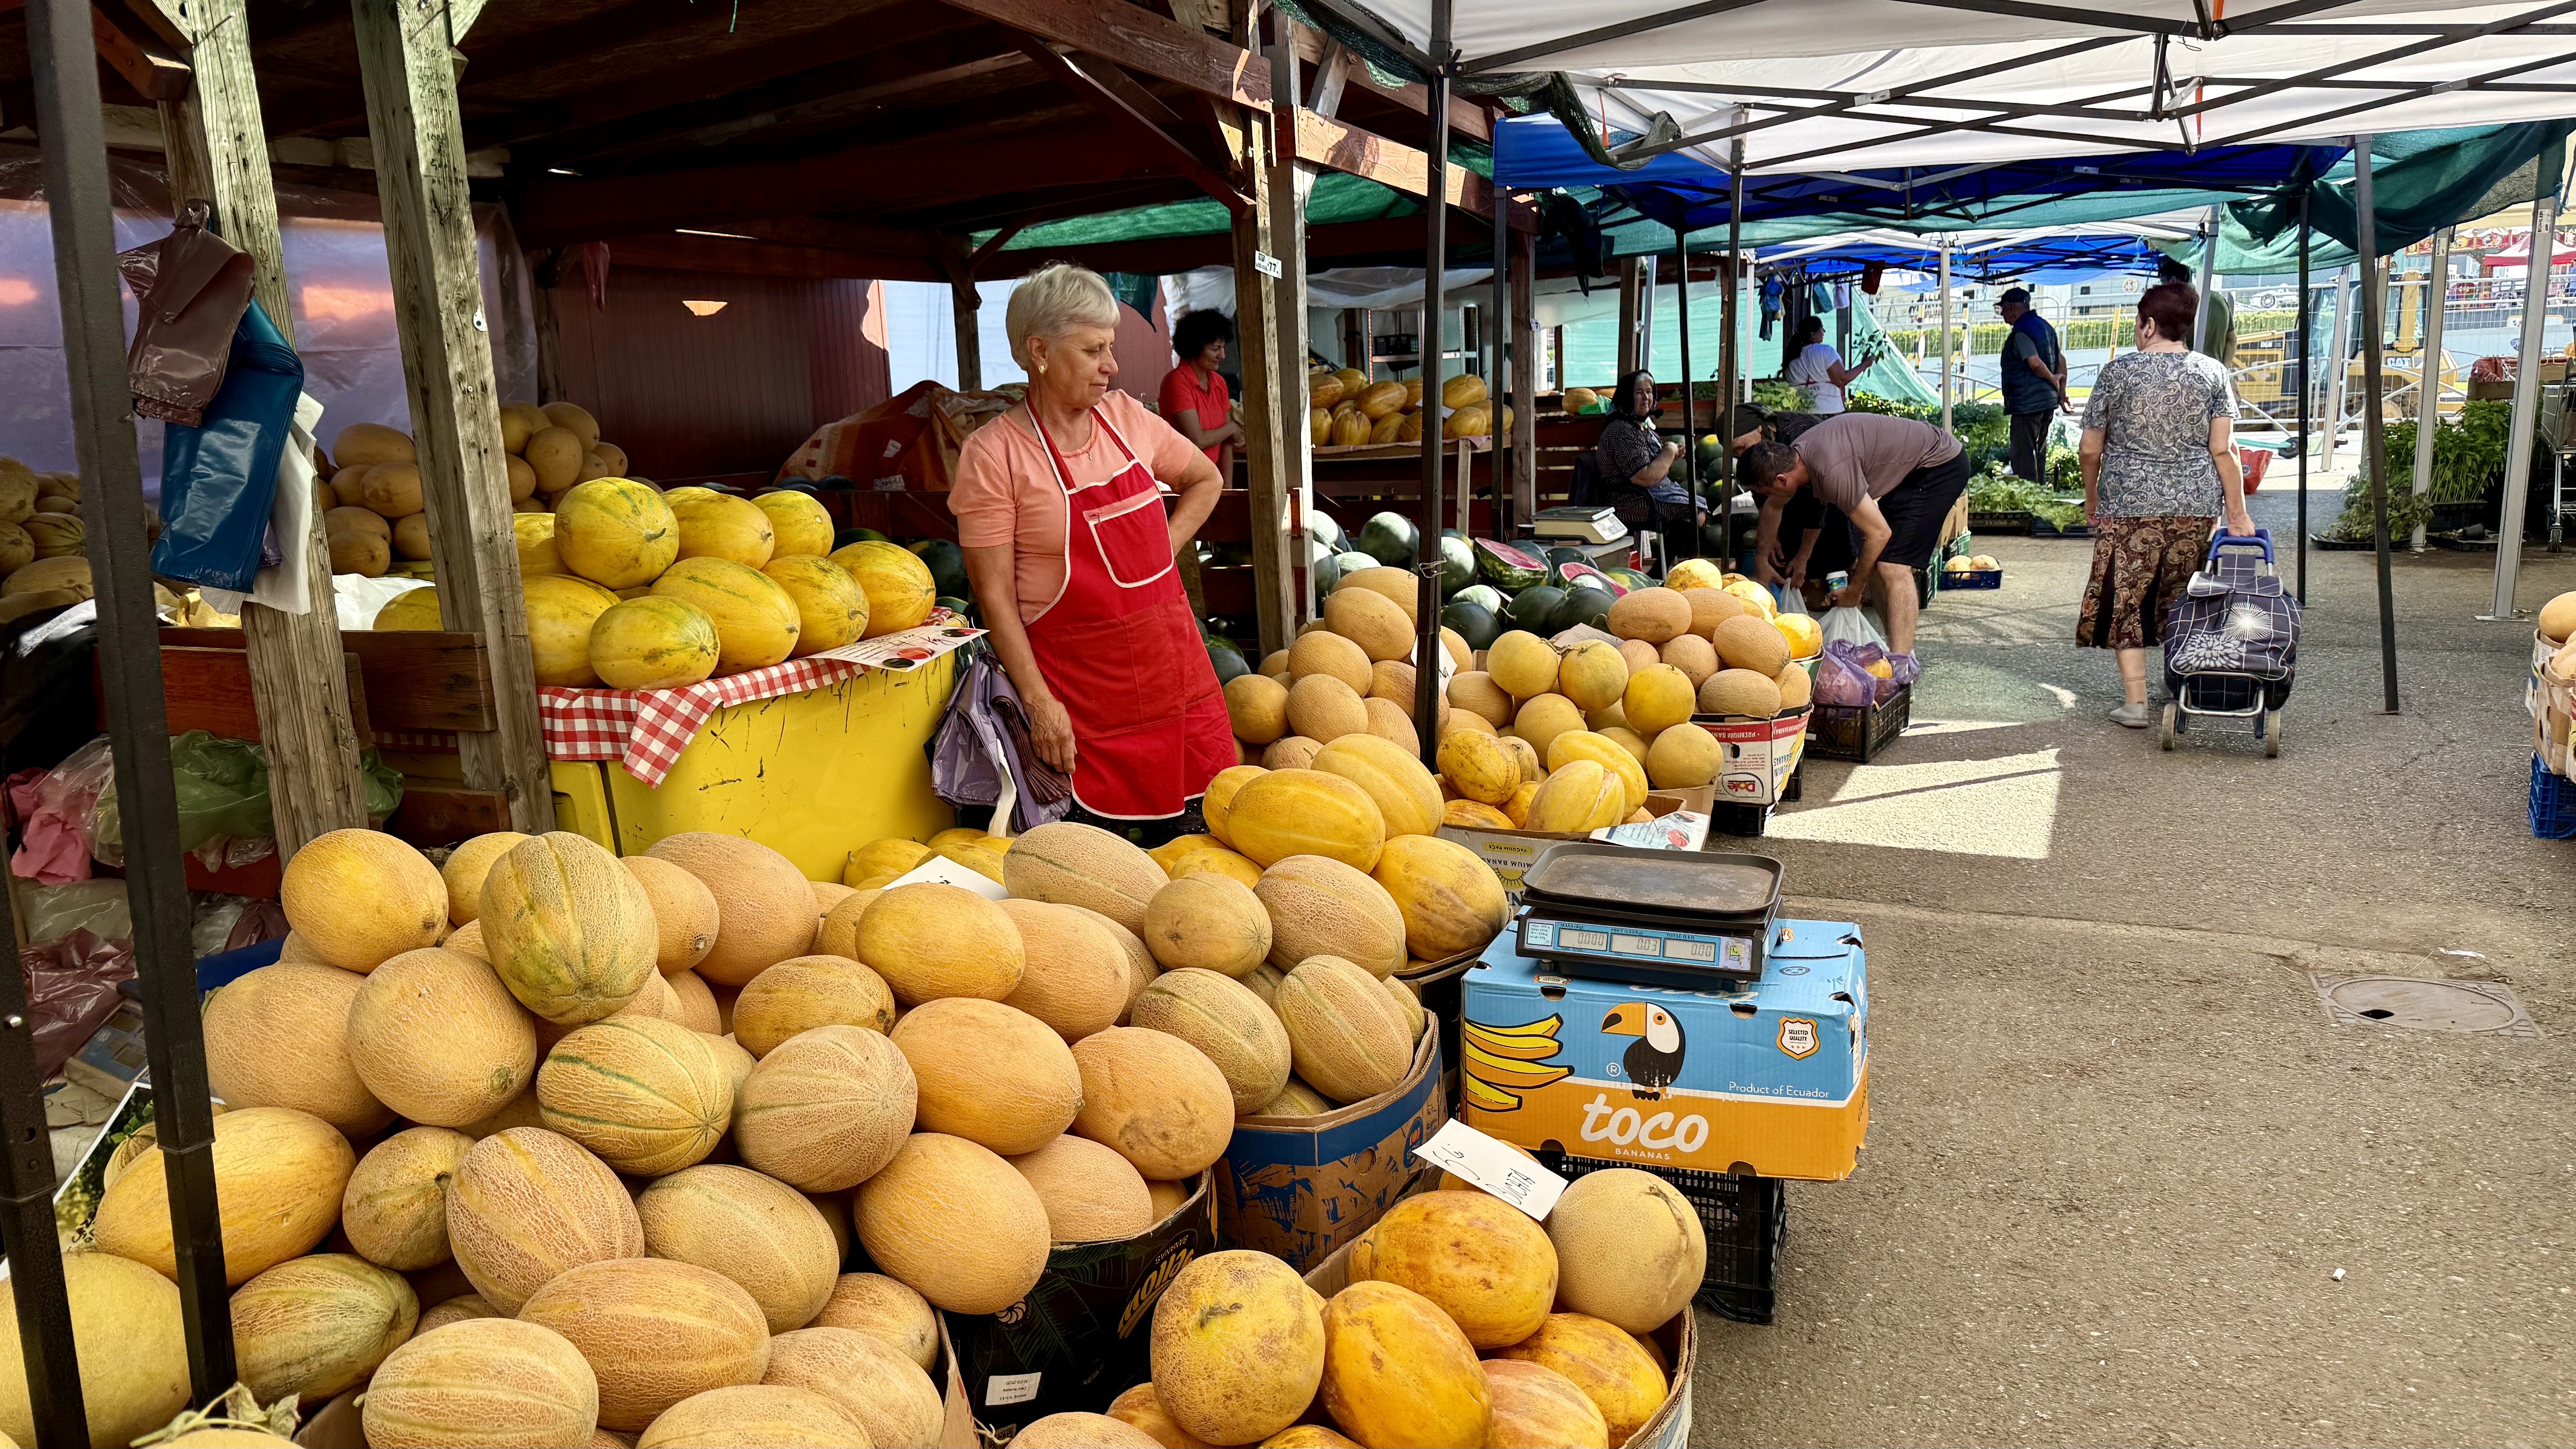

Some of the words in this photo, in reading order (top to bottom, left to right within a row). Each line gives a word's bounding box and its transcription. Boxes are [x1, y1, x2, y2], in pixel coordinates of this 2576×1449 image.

[2387, 357, 2411, 367] CAT
[1727, 782, 1756, 792] Dole
[1730, 1081, 1769, 1094] Product
[1772, 1085, 1784, 1095] of
[1786, 1086, 1829, 1098] Ecuador
[1581, 1093, 1709, 1152] toco
[1615, 1148, 1670, 1160] BANANAS
[1155, 1234, 1189, 1265] BANANAS
